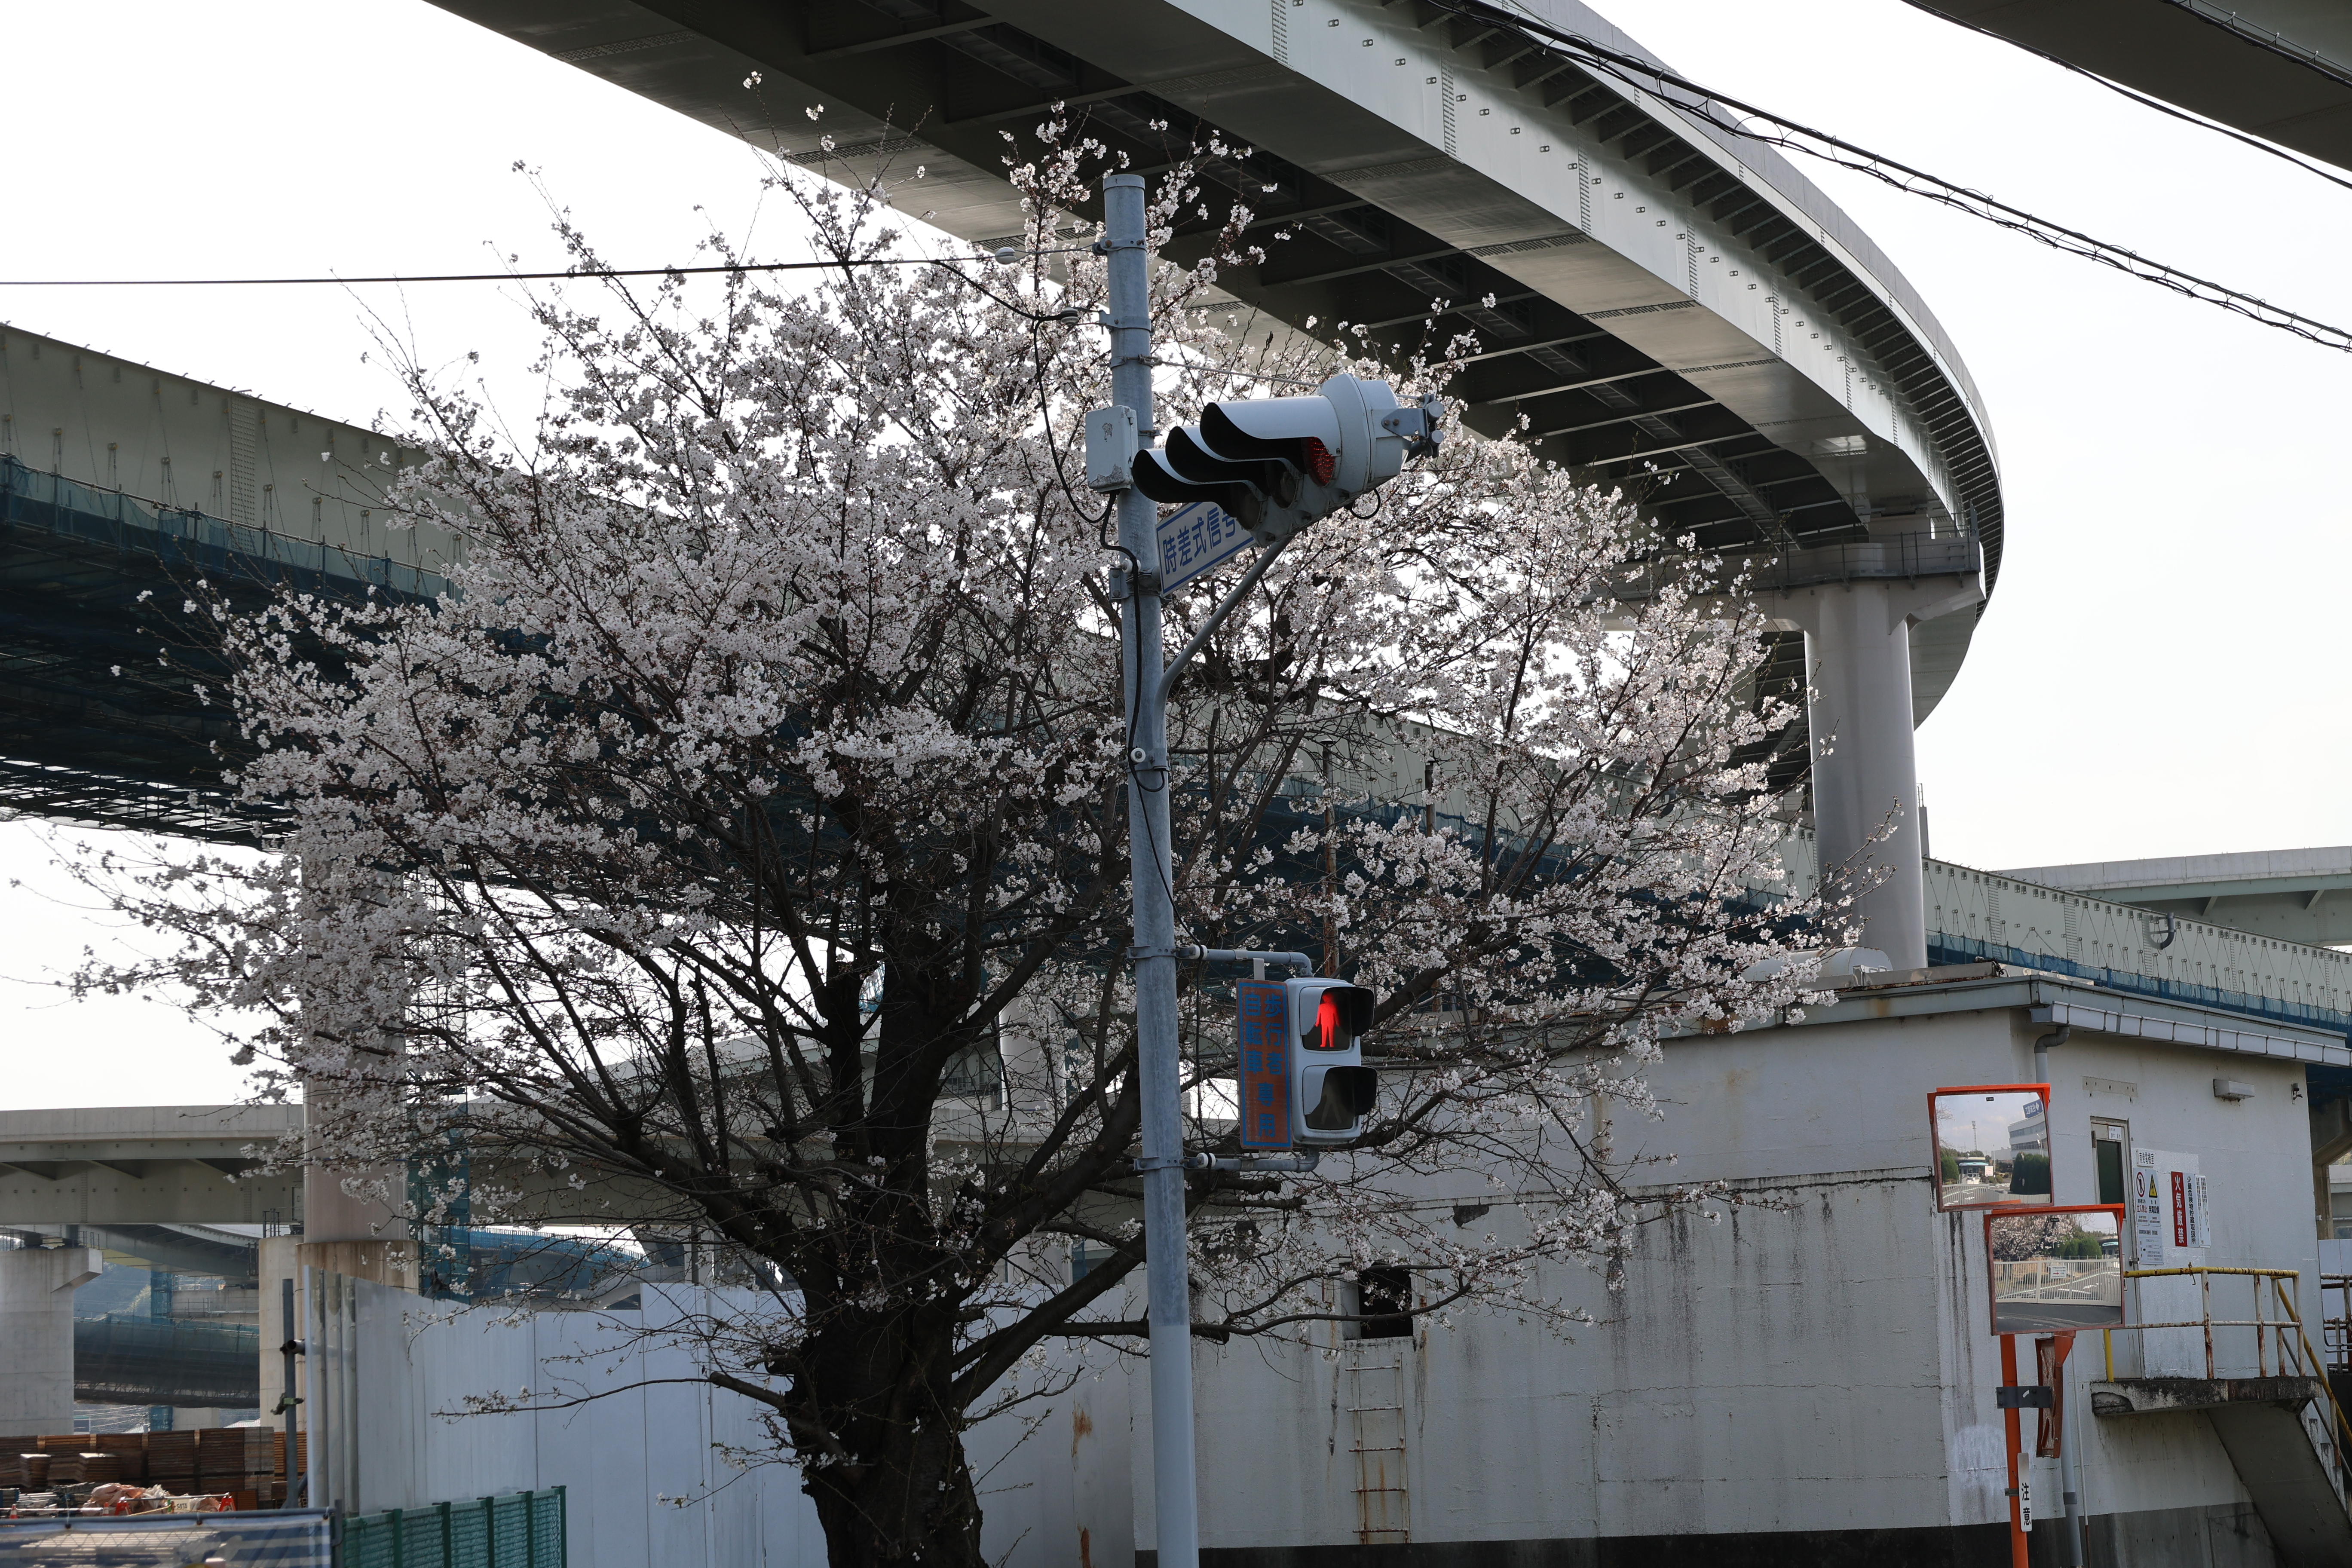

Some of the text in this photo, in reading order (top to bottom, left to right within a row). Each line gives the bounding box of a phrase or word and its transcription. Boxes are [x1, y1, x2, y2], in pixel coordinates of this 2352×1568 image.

[1163, 507, 1243, 575] 時差式信号
[1245, 992, 1263, 1074] 自転車
[1264, 993, 1283, 1075] 歩行者
[1257, 1082, 1275, 1137] 専用
[2137, 1205, 2148, 1213] 立入禁止
[2174, 1175, 2184, 1243] 火気厳禁
[2187, 1176, 2196, 1244] 少量危険物貯蔵取扱所
[2021, 1482, 2031, 1526] 注意
